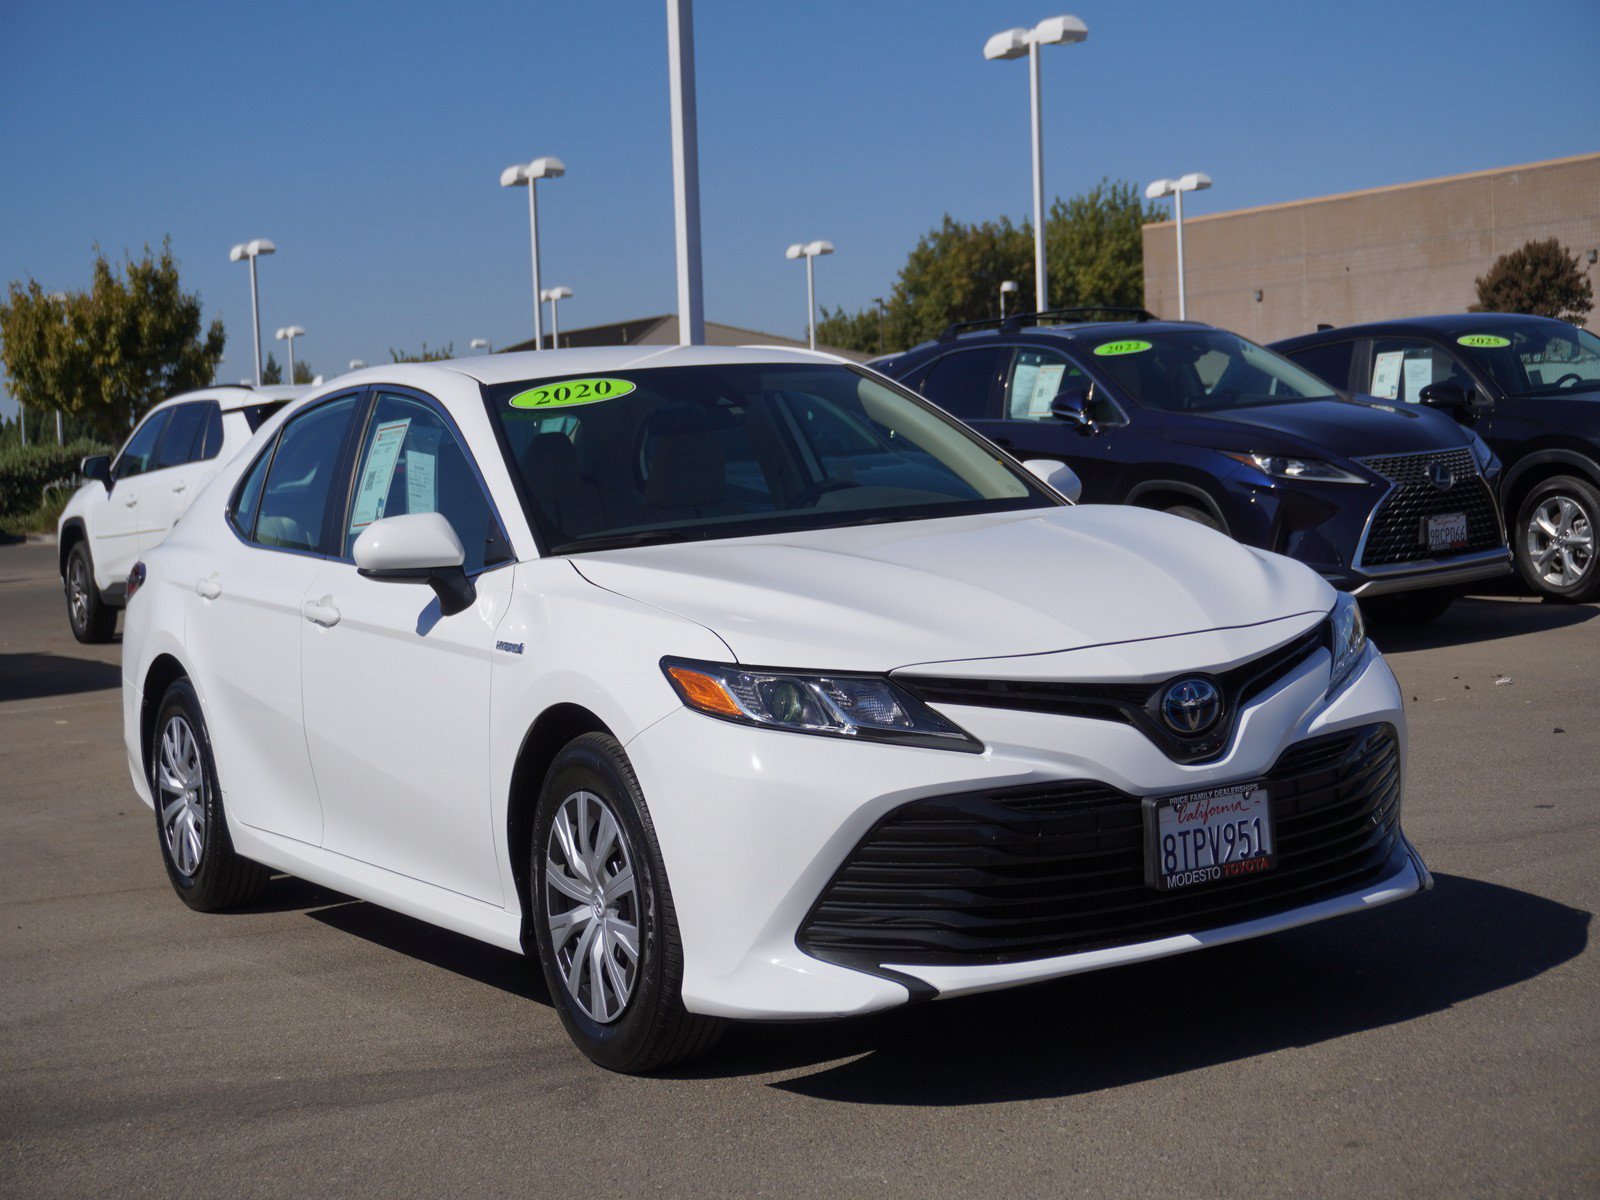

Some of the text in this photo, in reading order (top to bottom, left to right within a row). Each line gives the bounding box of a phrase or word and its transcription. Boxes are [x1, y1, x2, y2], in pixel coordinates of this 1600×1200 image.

[534, 380, 612, 406] 2020
[1169, 783, 1259, 806] PRICE FAMILY DEALERSHIPS
[1177, 799, 1250, 825] California
[1162, 816, 1267, 874] 8TPV951
[1166, 857, 1271, 889] MODESTO TOYOTA
